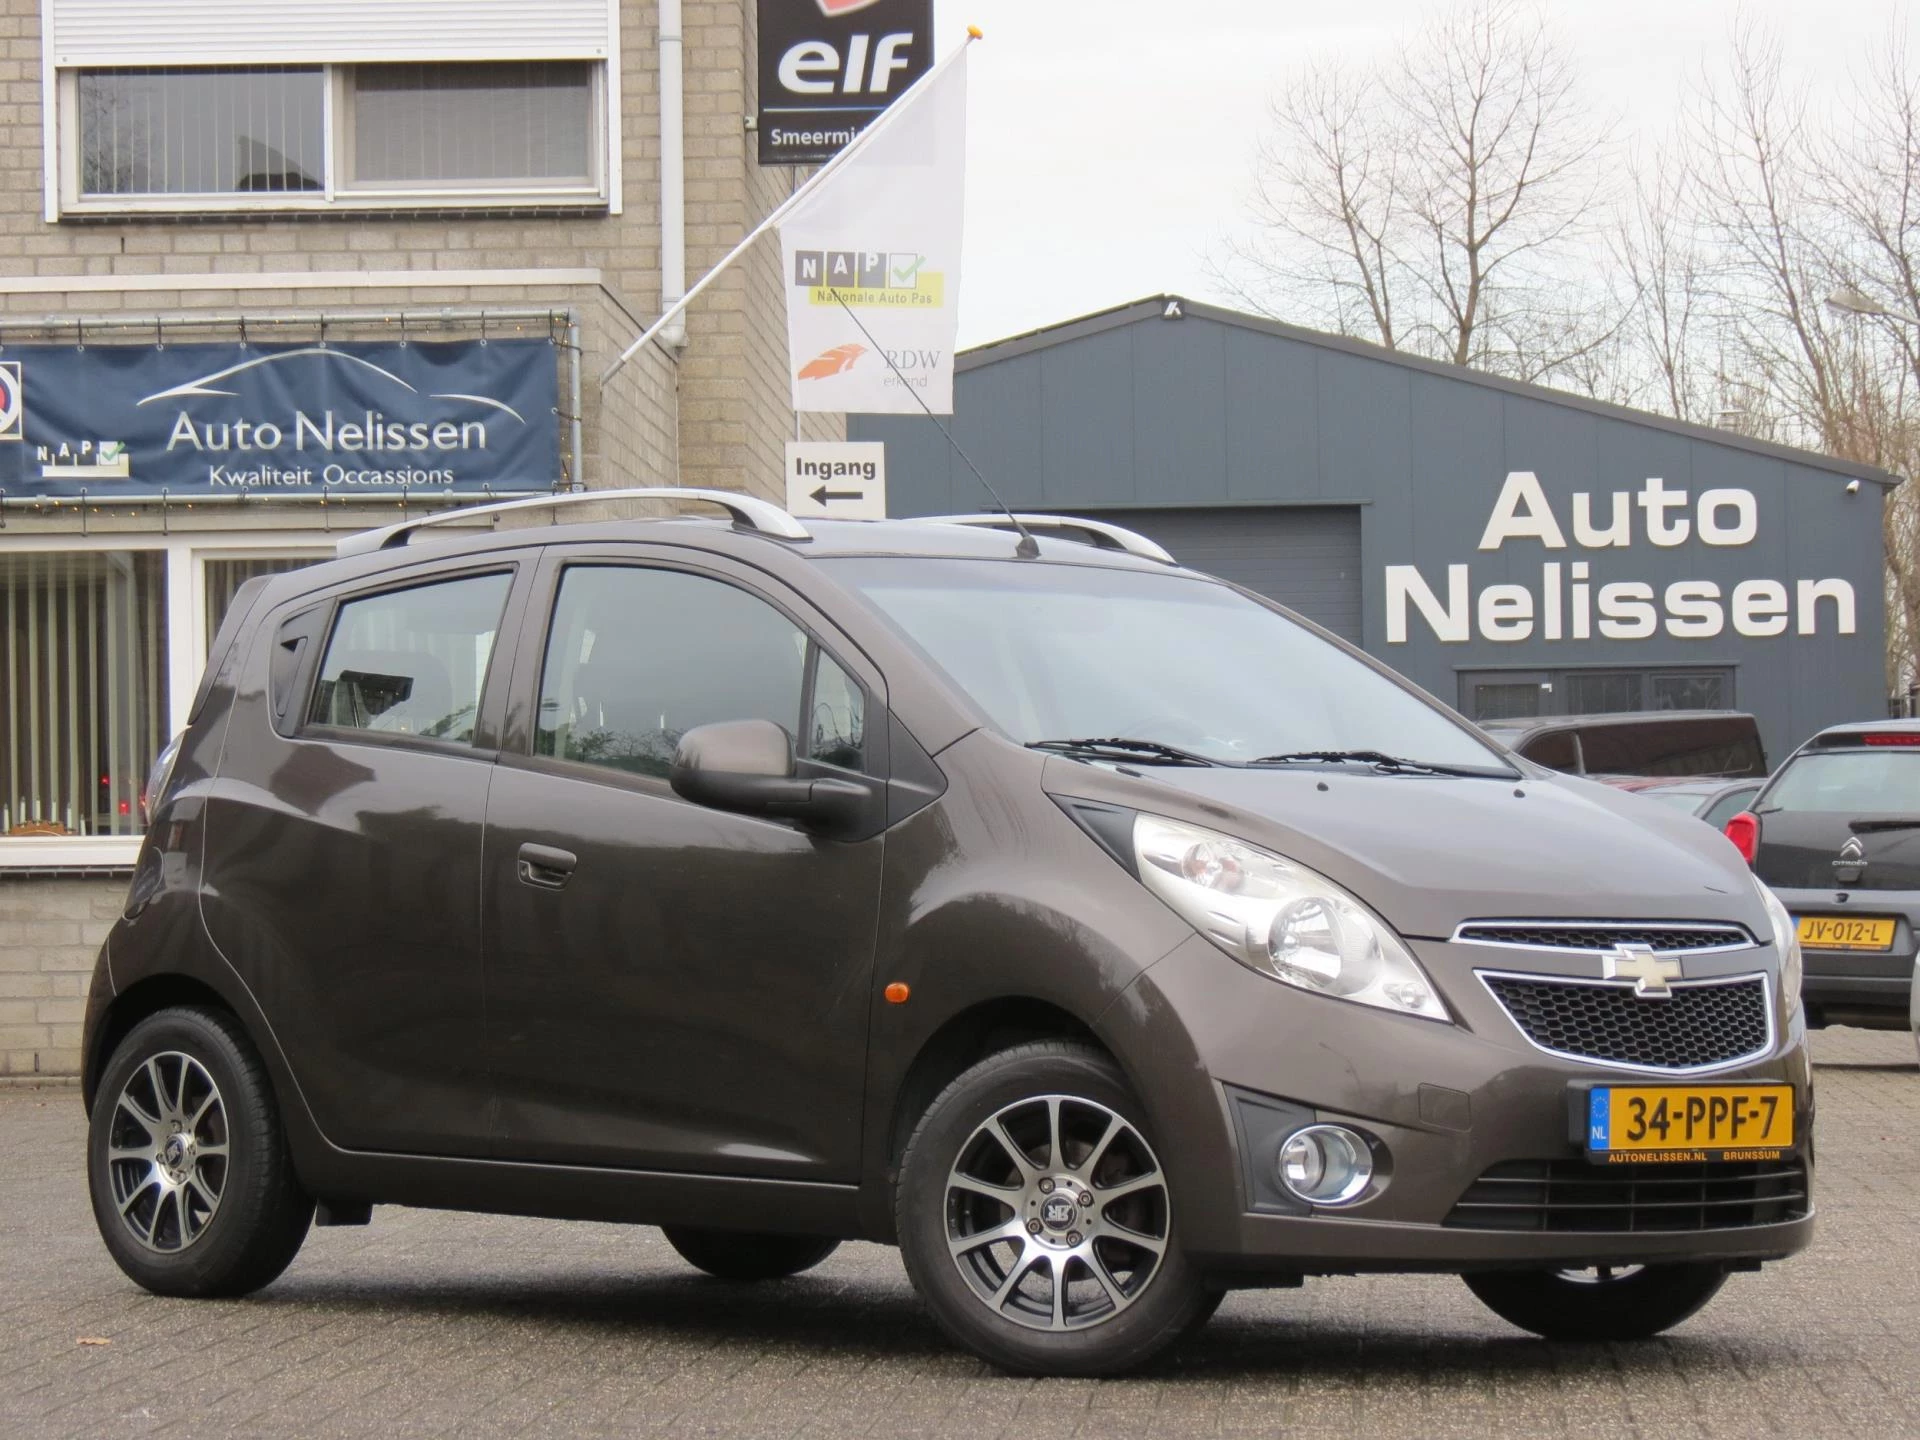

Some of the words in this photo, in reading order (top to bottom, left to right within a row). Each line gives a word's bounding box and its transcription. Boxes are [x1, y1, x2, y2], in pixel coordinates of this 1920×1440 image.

[778, 32, 913, 93] elf
[771, 126, 867, 146] Smeermi
[817, 291, 874, 303] Nationale
[879, 293, 907, 304] Auto
[911, 293, 932, 304] Pas
[885, 350, 942, 369] RDW
[166, 412, 282, 451] Auto
[296, 411, 486, 450] Nelissen
[209, 465, 312, 486] Kwaliteit
[323, 464, 454, 485] Occassions
[796, 457, 876, 480] Ingang
[1478, 471, 1758, 549] Auto
[1385, 562, 1856, 643] Nelissen
[1804, 921, 1880, 942] JV-012-L
[1627, 1096, 1779, 1141] 34-PPF-7
[1592, 1126, 1607, 1140] NL
[1609, 1152, 1707, 1163] AUTONELISSEN.NL
[1723, 1151, 1780, 1161] BRUNSSUM
